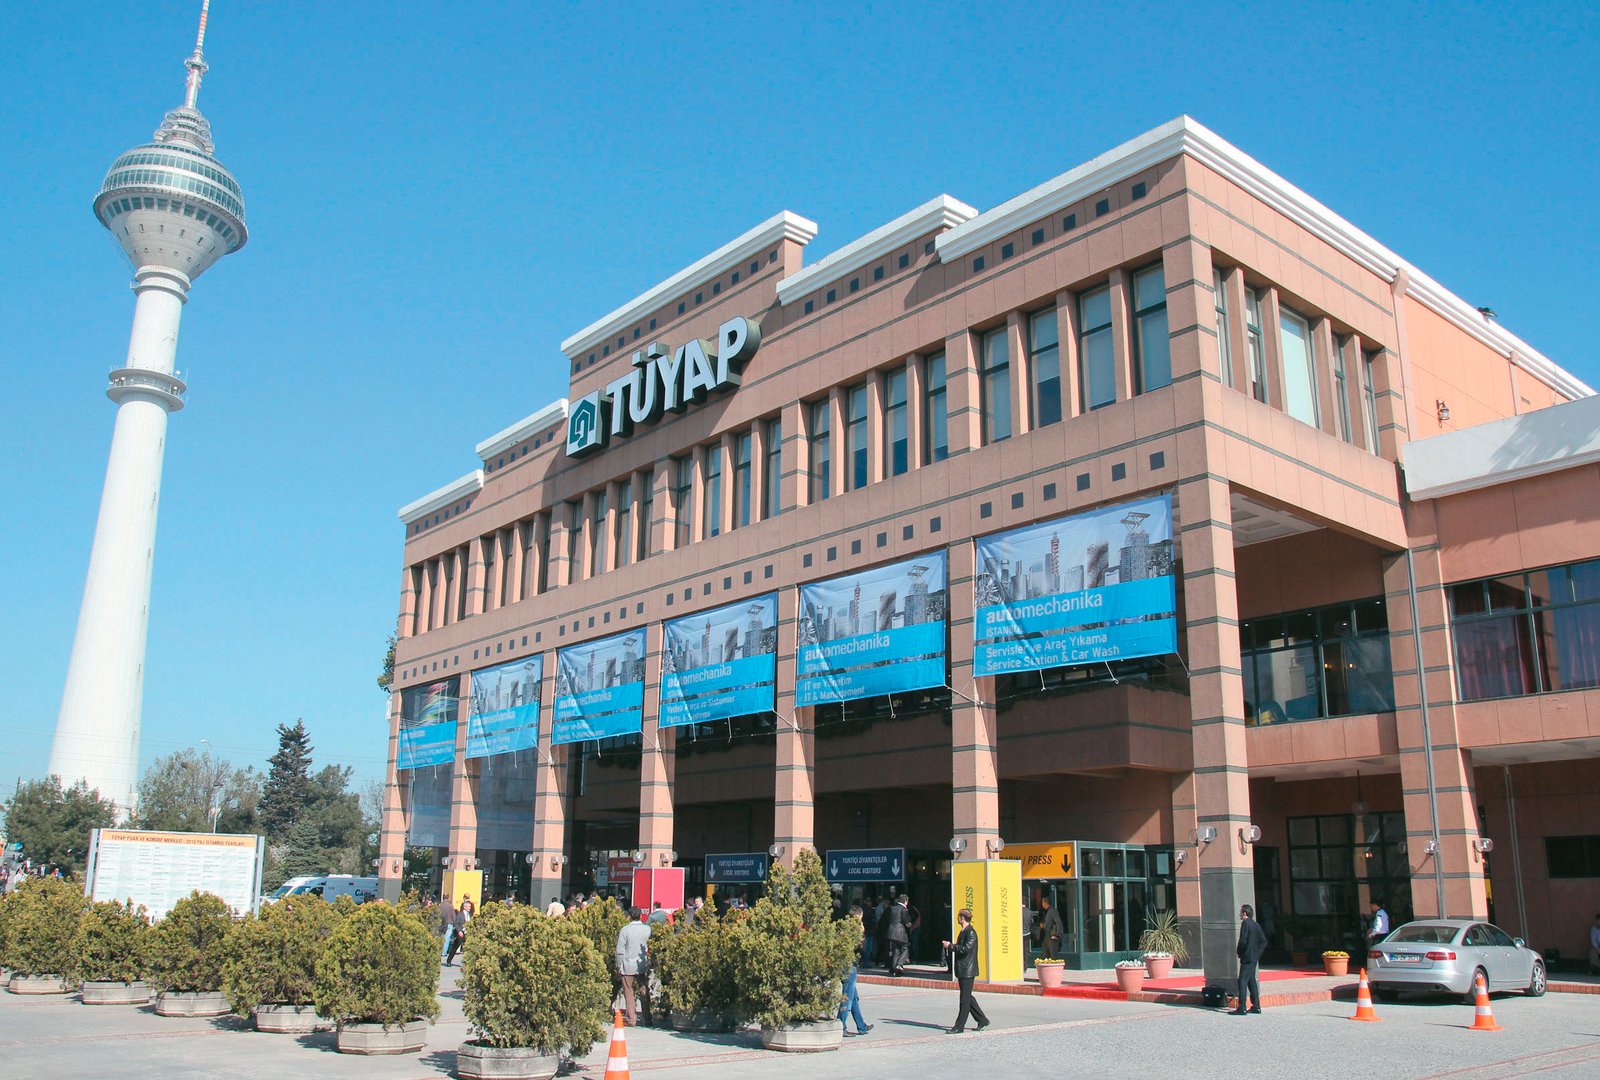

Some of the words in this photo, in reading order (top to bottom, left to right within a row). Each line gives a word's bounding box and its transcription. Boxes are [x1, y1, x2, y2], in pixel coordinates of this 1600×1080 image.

[605, 316, 757, 436] TÜYAP
[986, 592, 1103, 624] automechanika
[1044, 639, 1066, 651] Araç
[1069, 633, 1108, 646] Yıkama
[986, 658, 1020, 671] Service
[1071, 648, 1088, 660] Car
[1091, 645, 1120, 658] Wash
[848, 867, 861, 875] LOCAL
[1027, 854, 1053, 865] PRESS
[1000, 886, 1008, 918] PRESS
[1001, 925, 1009, 953] BASIN
